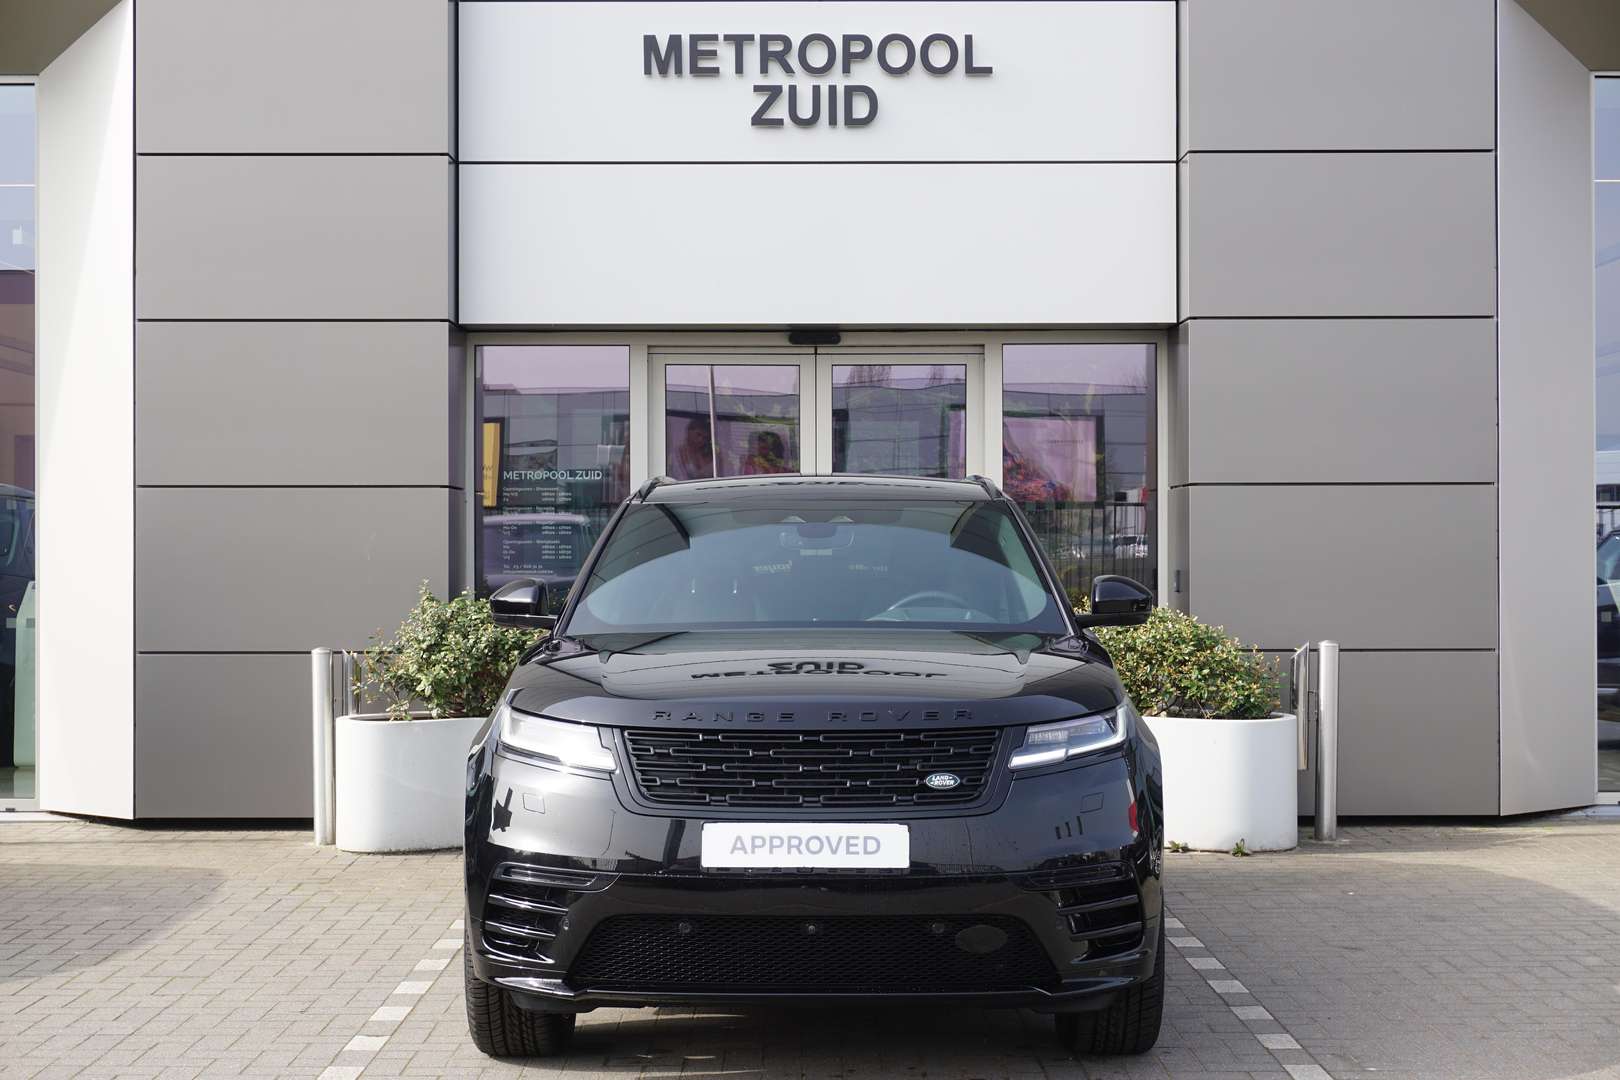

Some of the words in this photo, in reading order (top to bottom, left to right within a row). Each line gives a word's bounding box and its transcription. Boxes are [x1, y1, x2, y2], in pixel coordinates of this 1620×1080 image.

[642, 33, 993, 76] METROPOOL
[751, 84, 878, 127] ZUID
[503, 470, 573, 480] METROPOOL
[575, 470, 602, 480] ZUID
[652, 711, 796, 722] RANGE
[827, 710, 974, 722] ROVER
[729, 835, 881, 855] APPROVED
